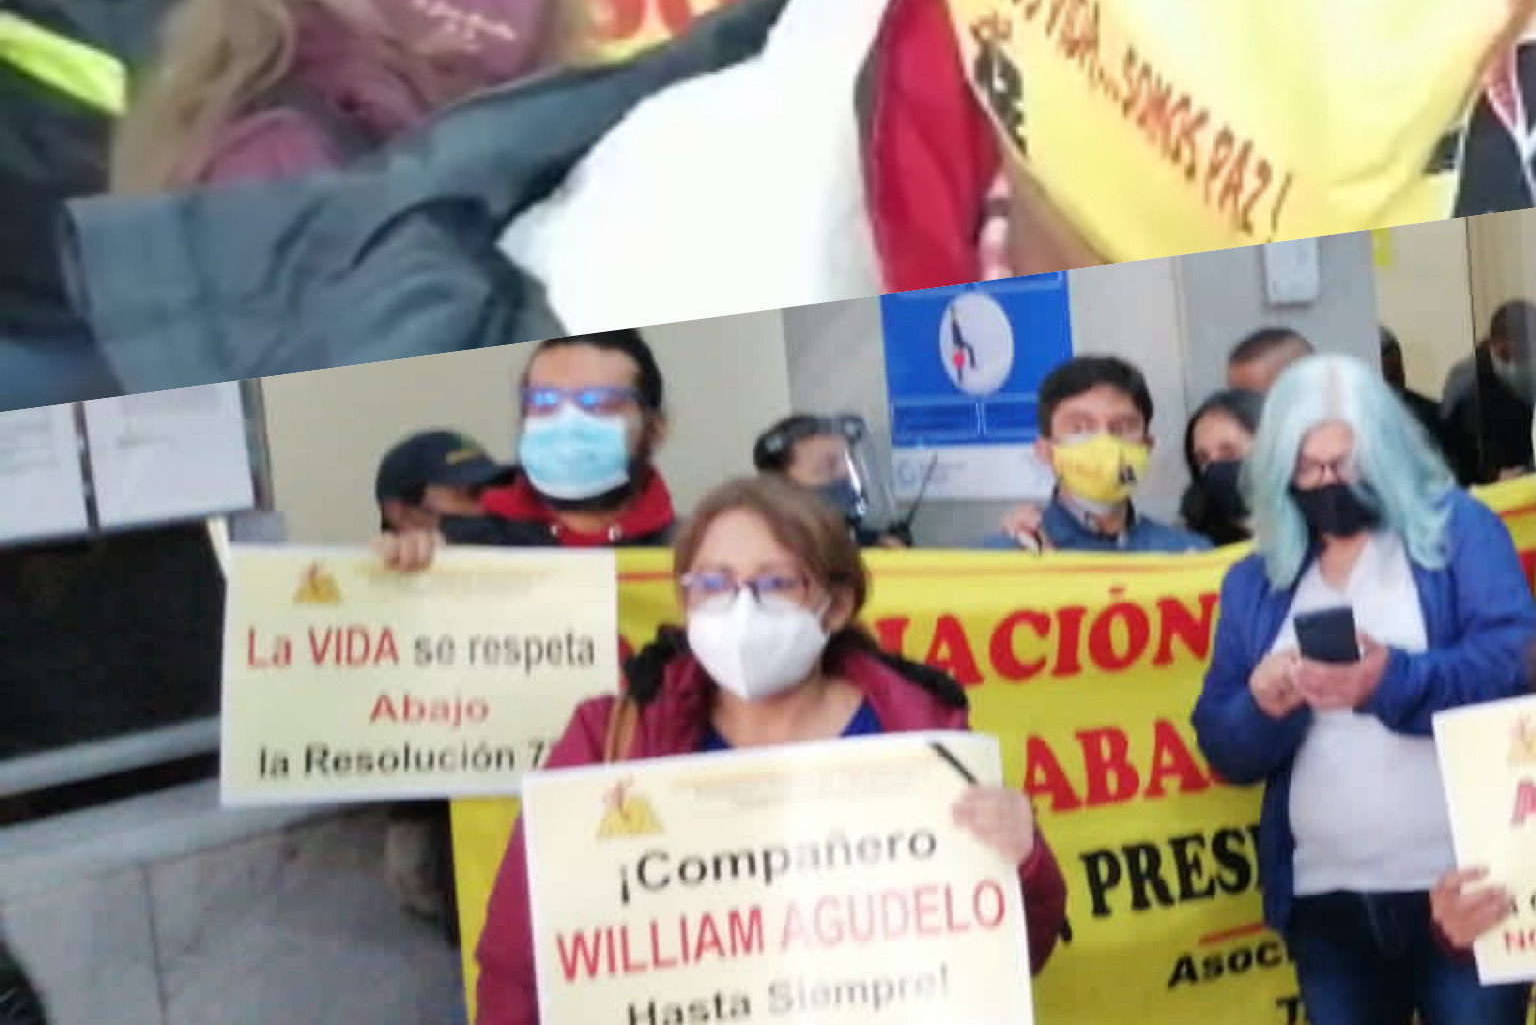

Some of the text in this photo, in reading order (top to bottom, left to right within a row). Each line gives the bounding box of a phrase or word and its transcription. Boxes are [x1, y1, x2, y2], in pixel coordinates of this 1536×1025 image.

[247, 625, 596, 675] La VIDA se respeta
[368, 692, 490, 728] Abajo
[258, 745, 290, 781] la
[304, 739, 514, 778] Resolución
[1023, 717, 1231, 813] ABA
[617, 825, 938, 905] ¡Compañero
[1080, 825, 1263, 918] PRES
[556, 877, 1007, 984] WILLIAM AGUDELO
[626, 960, 950, 1025] Hasta Siempre!
